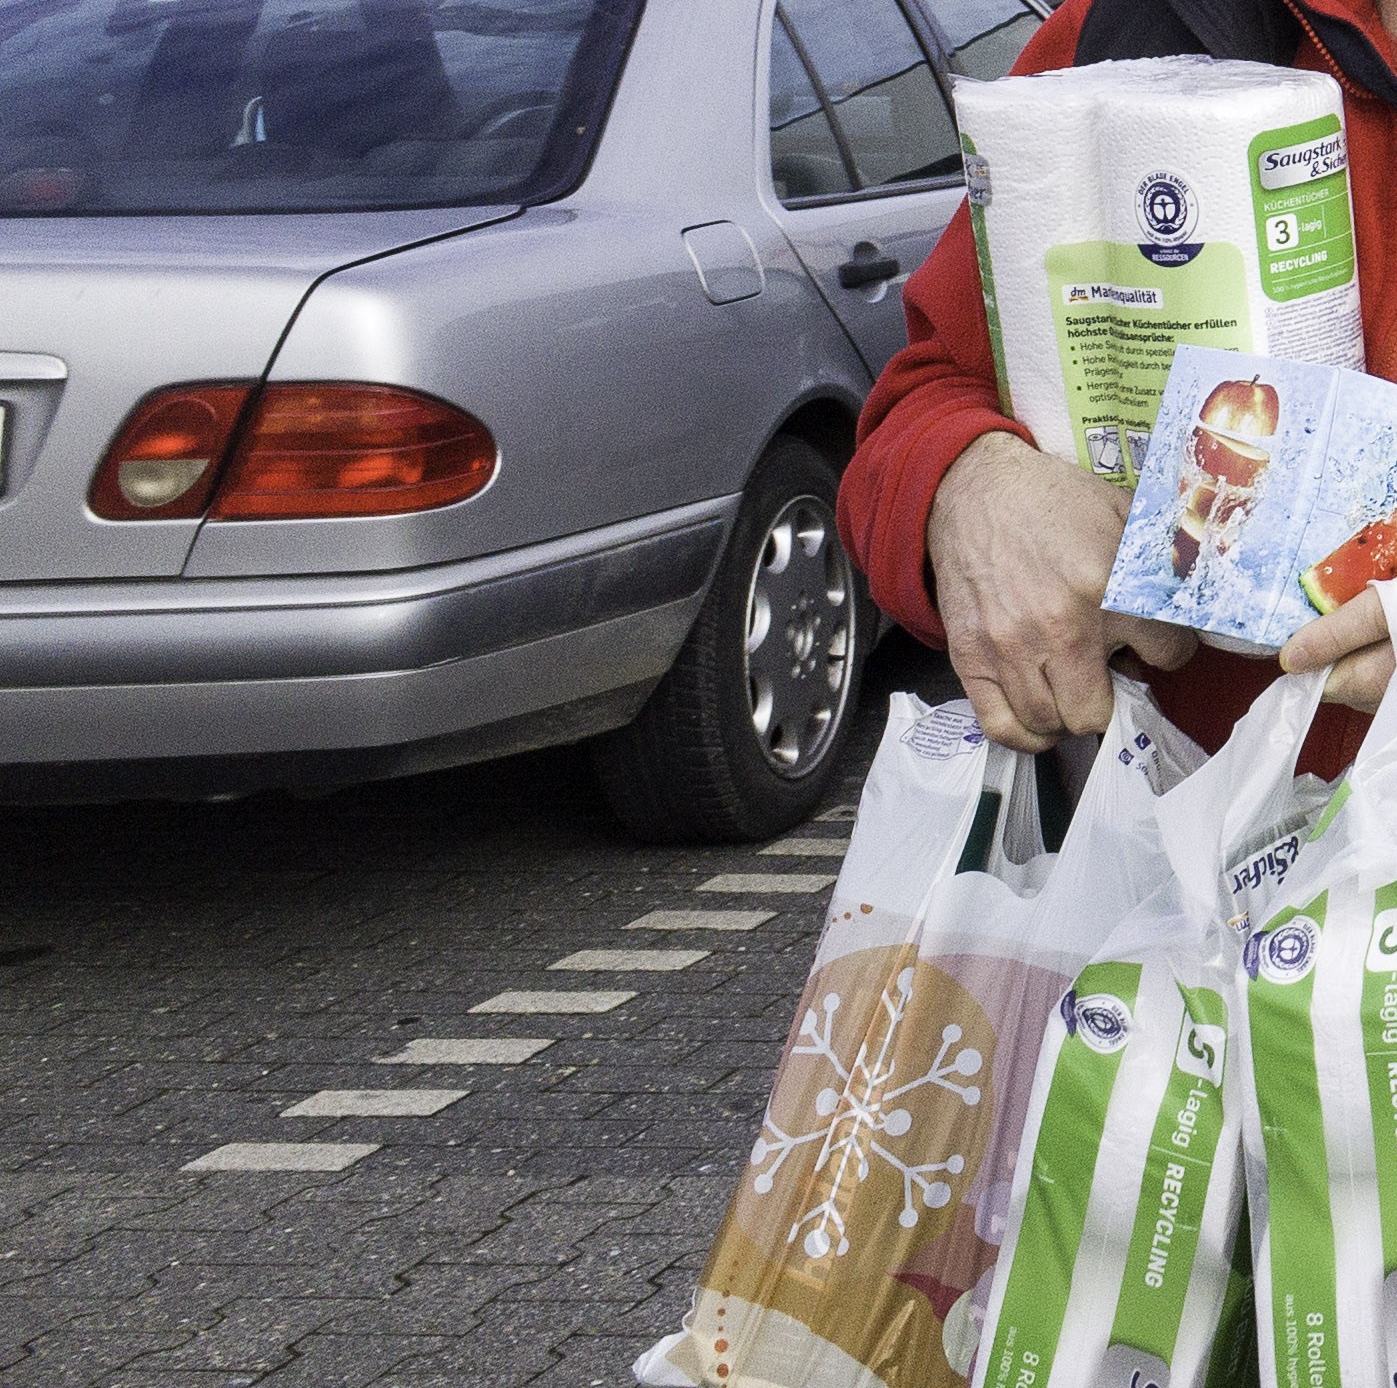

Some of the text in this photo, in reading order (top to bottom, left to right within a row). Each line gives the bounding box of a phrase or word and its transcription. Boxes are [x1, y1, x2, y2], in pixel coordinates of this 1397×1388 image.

[1264, 137, 1342, 171] Saugstark
[1263, 188, 1329, 211] KÜCHENTÜCHER
[1274, 219, 1290, 245] 3
[1270, 250, 1328, 274] RECYCLING
[1070, 286, 1087, 297] dm
[1067, 326, 1109, 338] höchste
[1132, 318, 1191, 331] Küchentücher
[1194, 318, 1238, 330] erfüllen
[1171, 1078, 1208, 1148] -lagig
[1144, 1162, 1185, 1288] RECYCLING
[1284, 1294, 1295, 1318] aus
[1305, 1312, 1325, 1327] 8
[1022, 1350, 1040, 1367] 8
